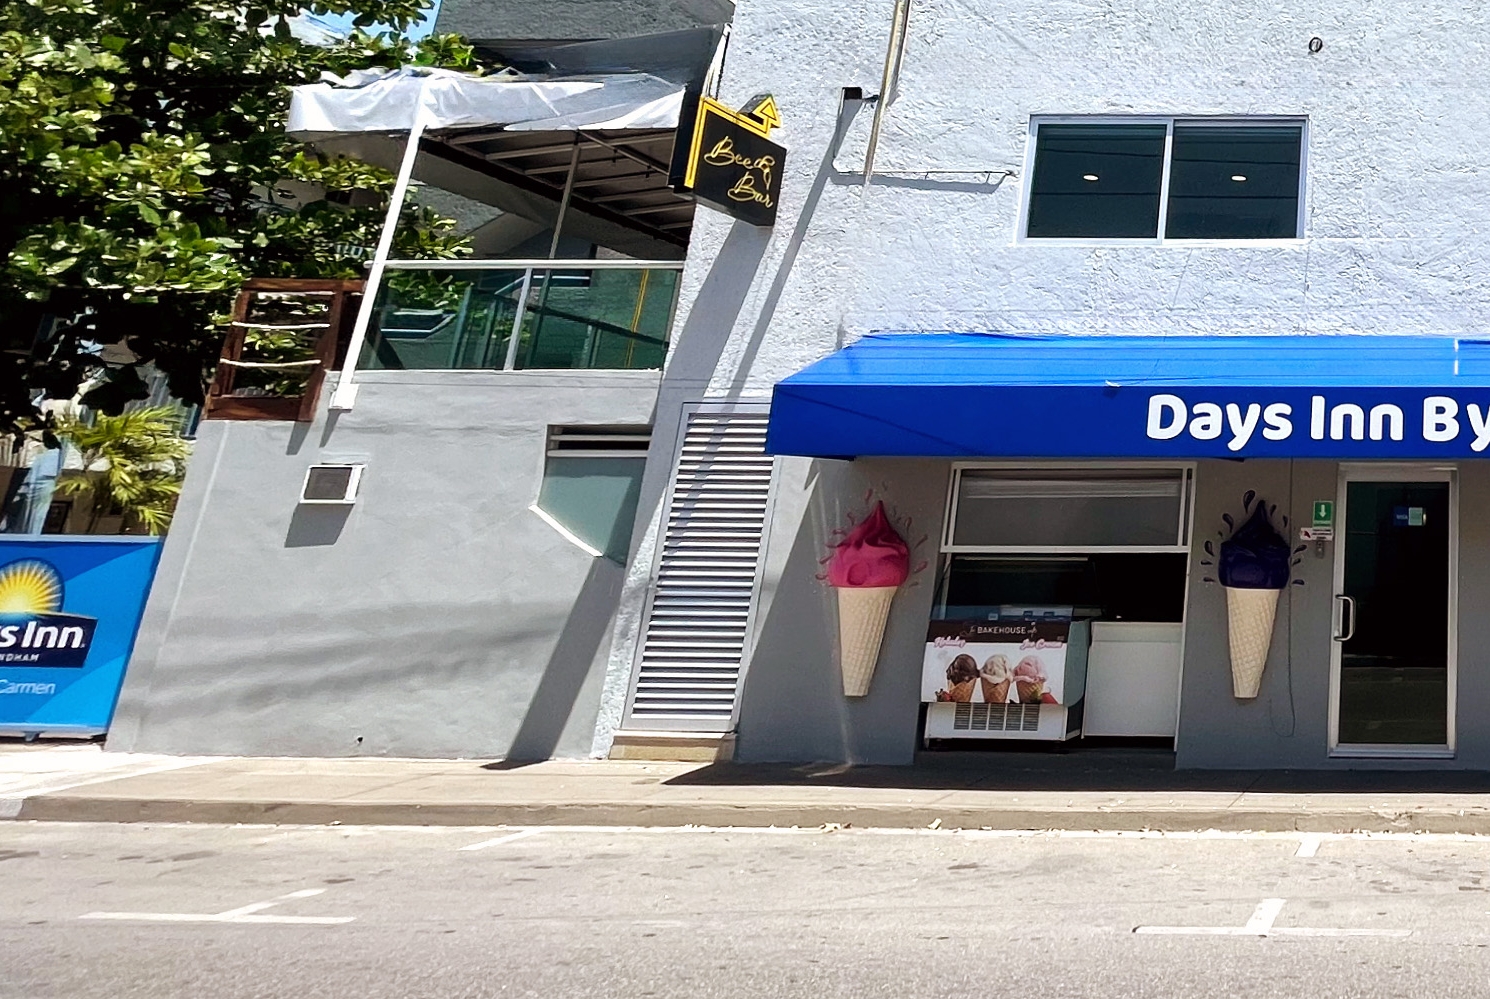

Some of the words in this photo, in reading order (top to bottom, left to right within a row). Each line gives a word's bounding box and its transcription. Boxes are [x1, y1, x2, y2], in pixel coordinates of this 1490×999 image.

[727, 171, 774, 208] Bar
[1146, 393, 1293, 451] Days
[1310, 395, 1404, 441] Inn
[21, 620, 84, 648] Inn
[977, 626, 1026, 635] BAKEHOUSE
[0, 679, 56, 695] Carmen
